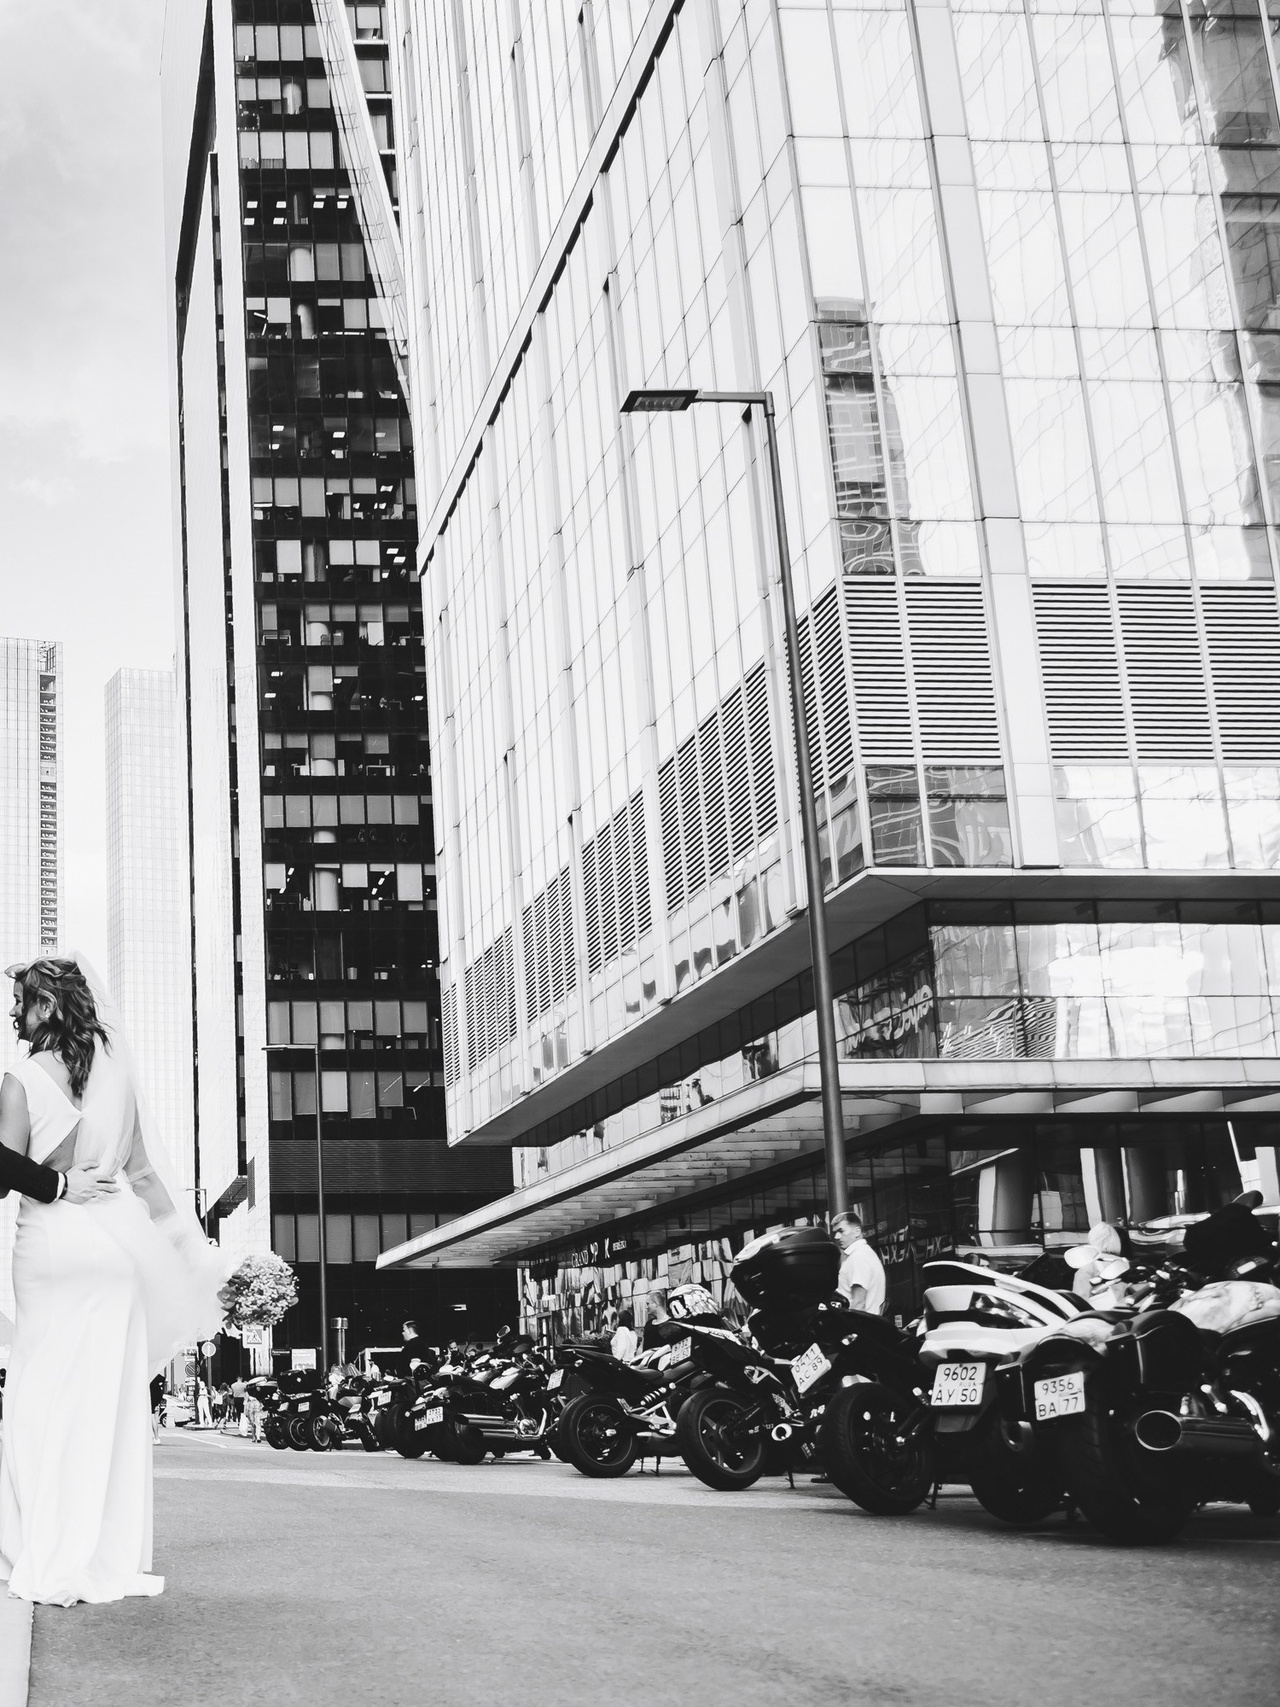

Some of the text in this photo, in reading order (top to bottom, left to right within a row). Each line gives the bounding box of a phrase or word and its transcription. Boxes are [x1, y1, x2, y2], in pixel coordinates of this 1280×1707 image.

[794, 1348, 816, 1373] 0411
[811, 1357, 823, 1371] 89
[943, 1366, 978, 1382] 9602
[1041, 1377, 1075, 1397] 9356
[960, 1388, 978, 1403] 50
[1063, 1396, 1079, 1412] 77
